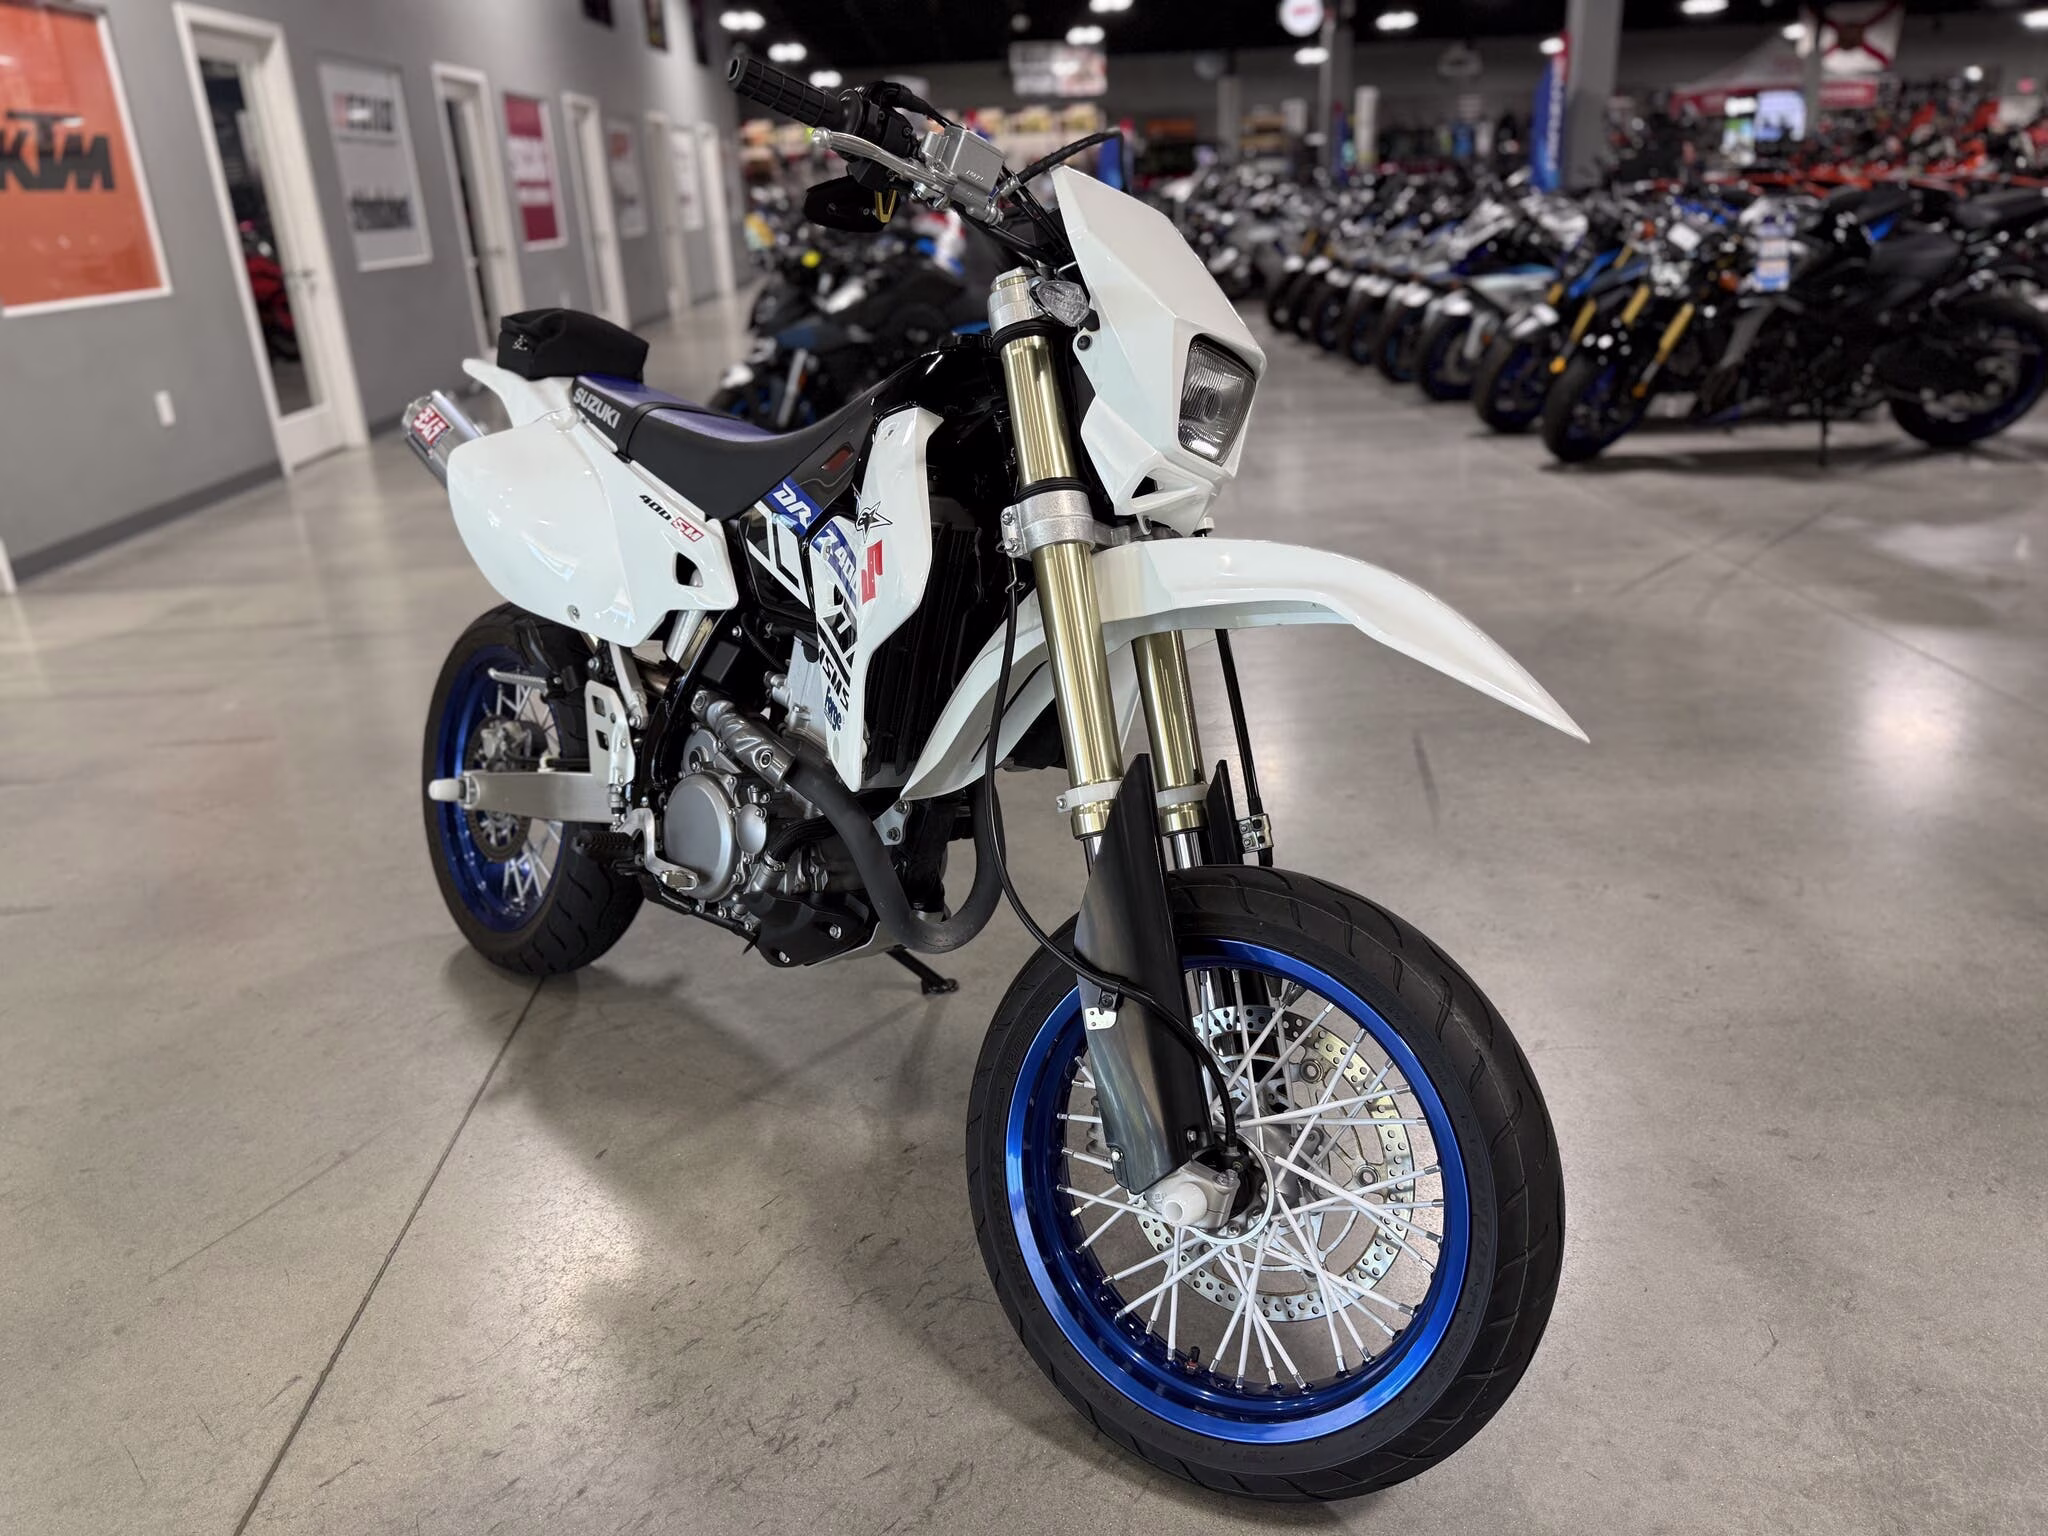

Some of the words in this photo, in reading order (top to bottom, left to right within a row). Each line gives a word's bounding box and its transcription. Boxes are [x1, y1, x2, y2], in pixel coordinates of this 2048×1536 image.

[0, 111, 115, 191] KTM
[573, 387, 621, 429] SUZUKI
[639, 495, 672, 520] 400
[671, 516, 704, 542] SM
[772, 481, 812, 529] DR
